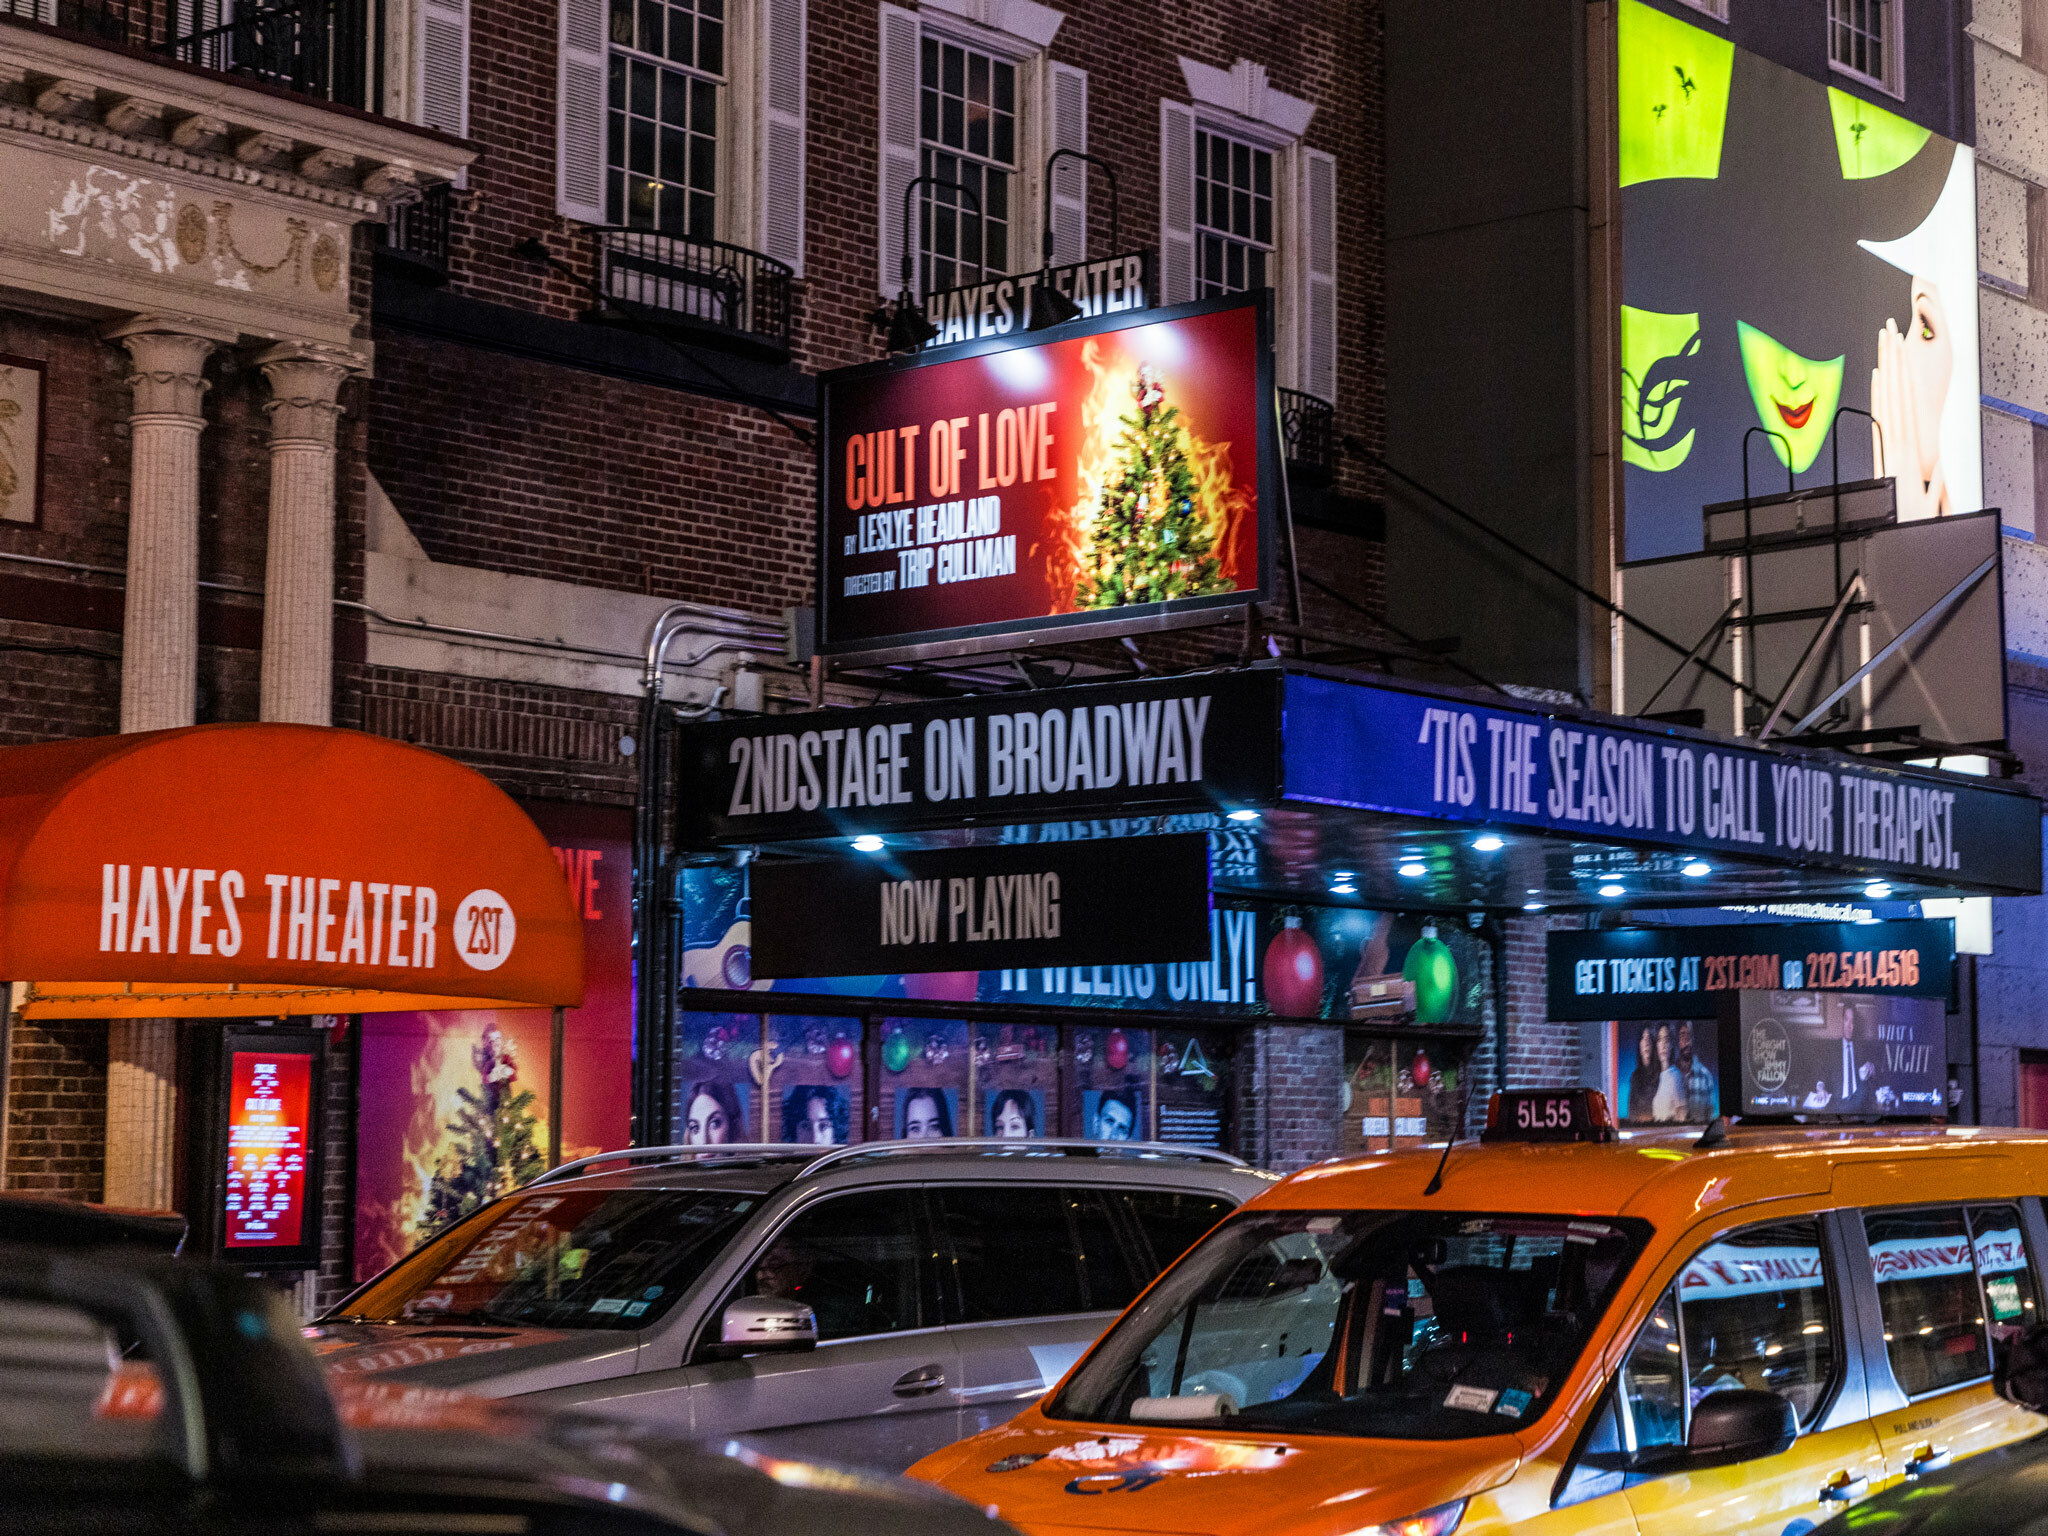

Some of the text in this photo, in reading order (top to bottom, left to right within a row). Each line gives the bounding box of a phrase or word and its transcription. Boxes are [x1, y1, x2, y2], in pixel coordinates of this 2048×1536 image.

[925, 256, 1143, 348] HAYES TEATER
[846, 401, 1058, 511] CULT OF LOVE
[844, 495, 1001, 556] BY LESLYE HEADLAND
[844, 534, 1017, 597] DIRECTED BY TRIP CULLMAN
[728, 696, 1212, 817] 2NDSTAGE ON BROADWAY
[1418, 707, 1960, 871] 'TIS THE SEASON TO CALL YOUR THERAPIST.
[100, 863, 504, 969] HAYES THEATER 2ST
[551, 846, 603, 920] VE
[880, 871, 1062, 946] NOW PLAYING
[1575, 948, 1920, 995] GET TICKETS AT 2ST.COM OR 212.541.4516
[1517, 1099, 1572, 1129] 5L55
